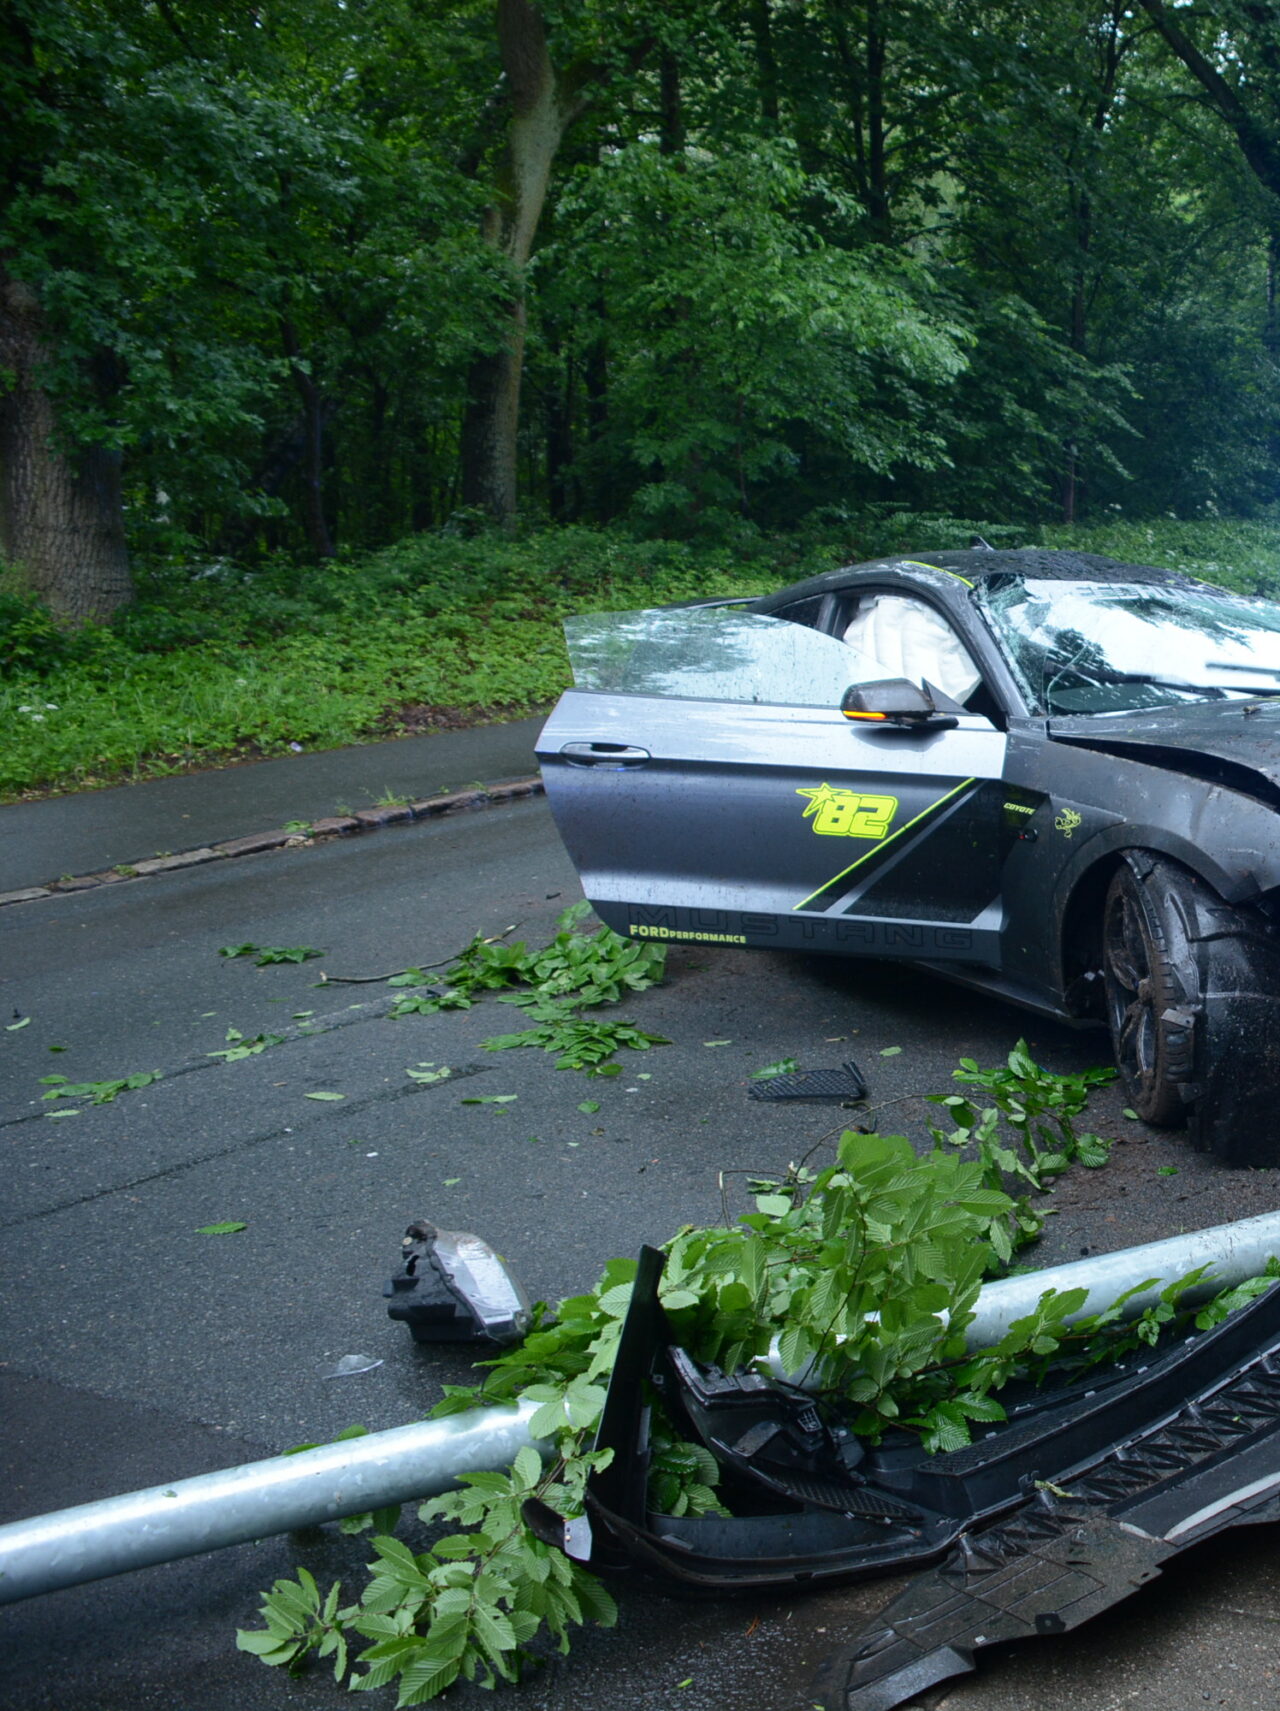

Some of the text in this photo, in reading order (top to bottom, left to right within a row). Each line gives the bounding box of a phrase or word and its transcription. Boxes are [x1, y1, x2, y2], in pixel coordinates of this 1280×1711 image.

[812, 793, 898, 838] 82
[1003, 802, 1036, 815] COYOTE
[627, 902, 973, 949] MUSTANG
